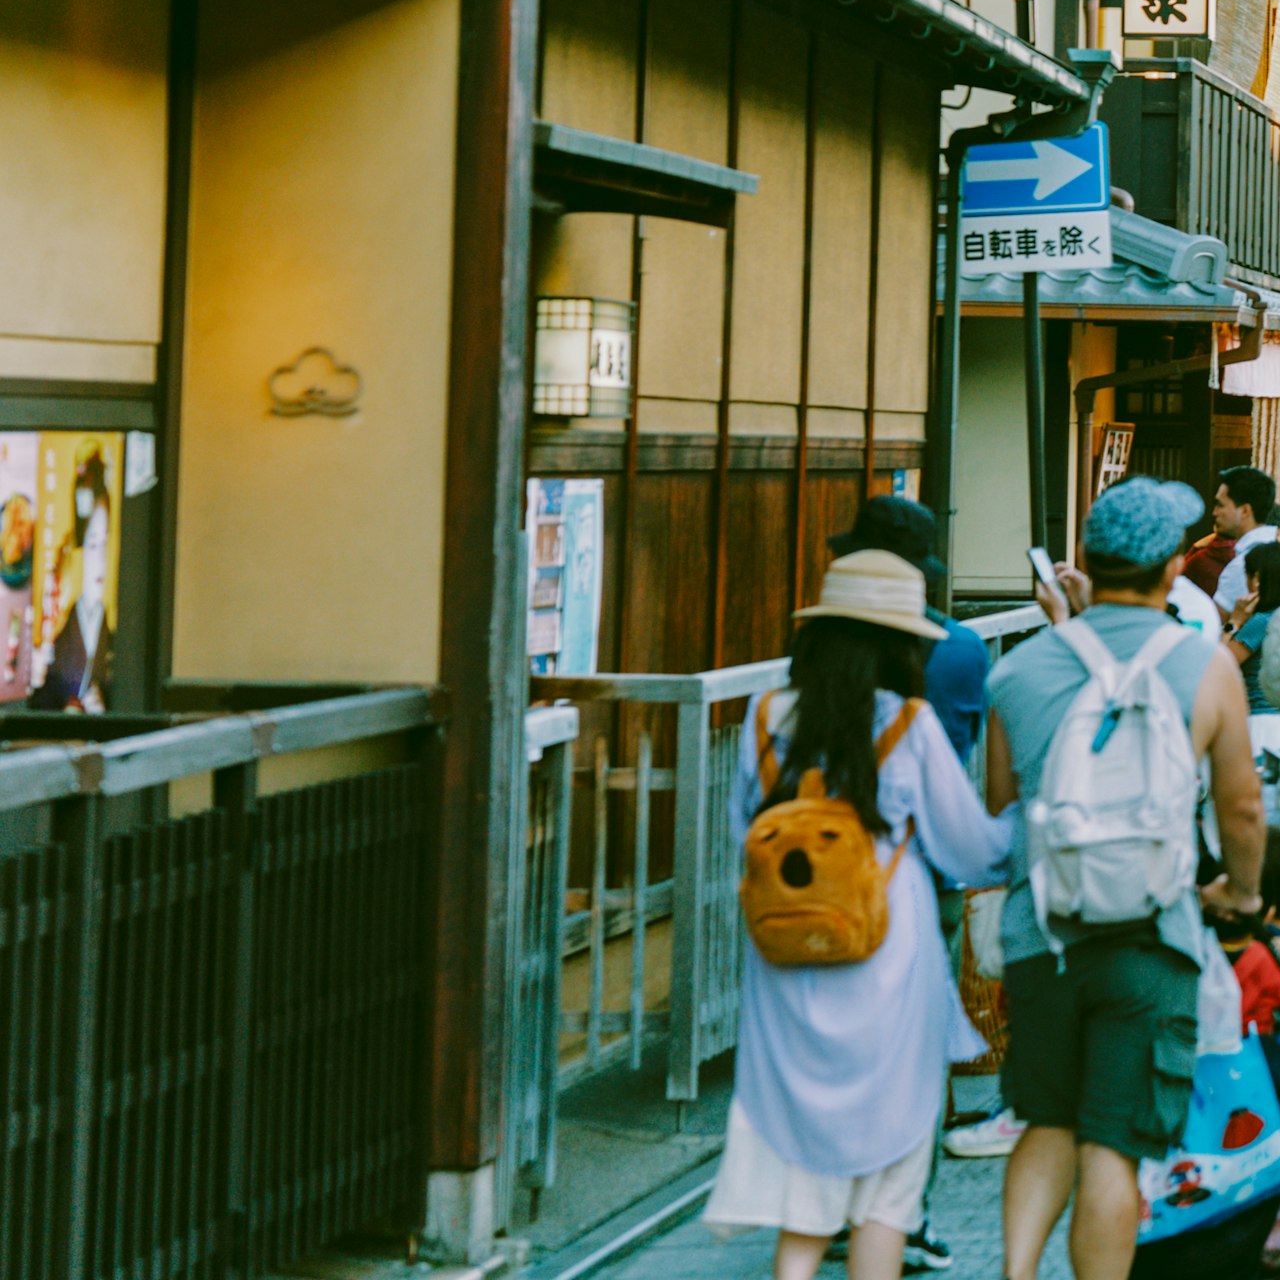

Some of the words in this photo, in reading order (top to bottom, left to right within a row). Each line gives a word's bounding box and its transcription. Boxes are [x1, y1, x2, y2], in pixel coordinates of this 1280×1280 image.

[964, 225, 1101, 261] 自転車を除く
